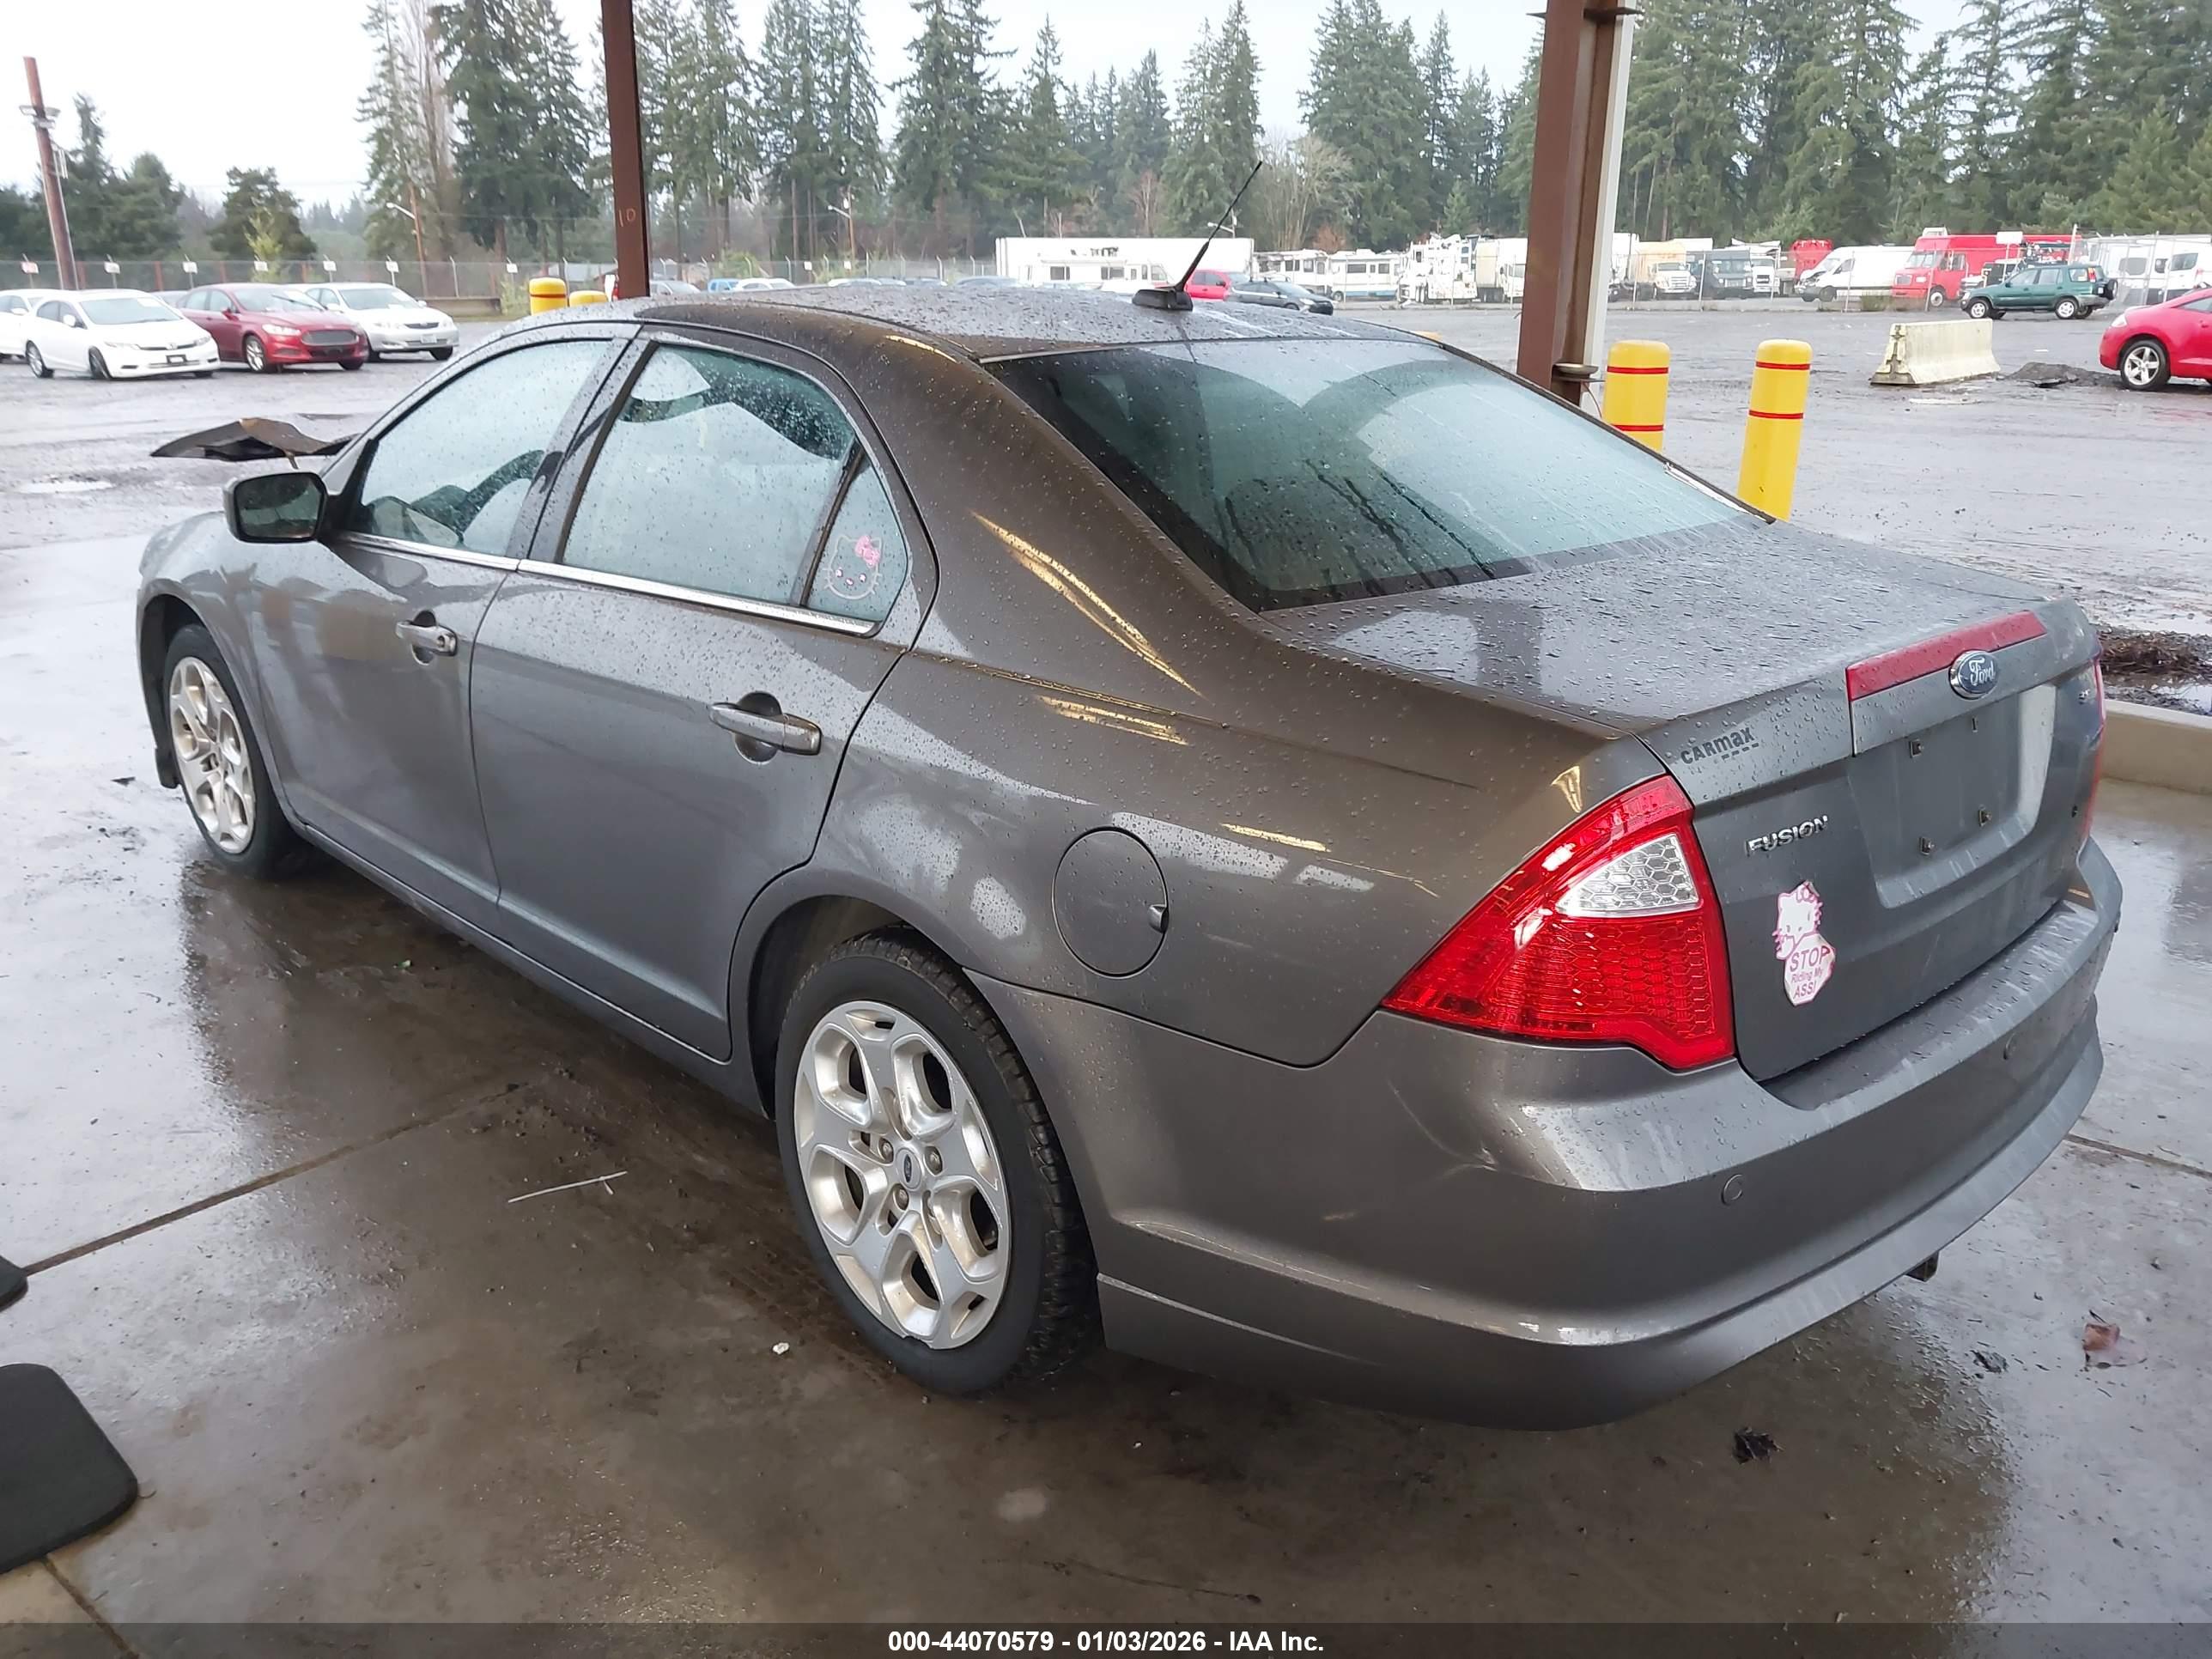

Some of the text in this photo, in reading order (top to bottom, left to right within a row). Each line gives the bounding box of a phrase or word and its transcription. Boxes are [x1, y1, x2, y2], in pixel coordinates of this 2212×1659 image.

[1968, 657, 1996, 687] Ford
[1745, 814, 1829, 857] FUSION
[1790, 945, 1831, 972] STOP
